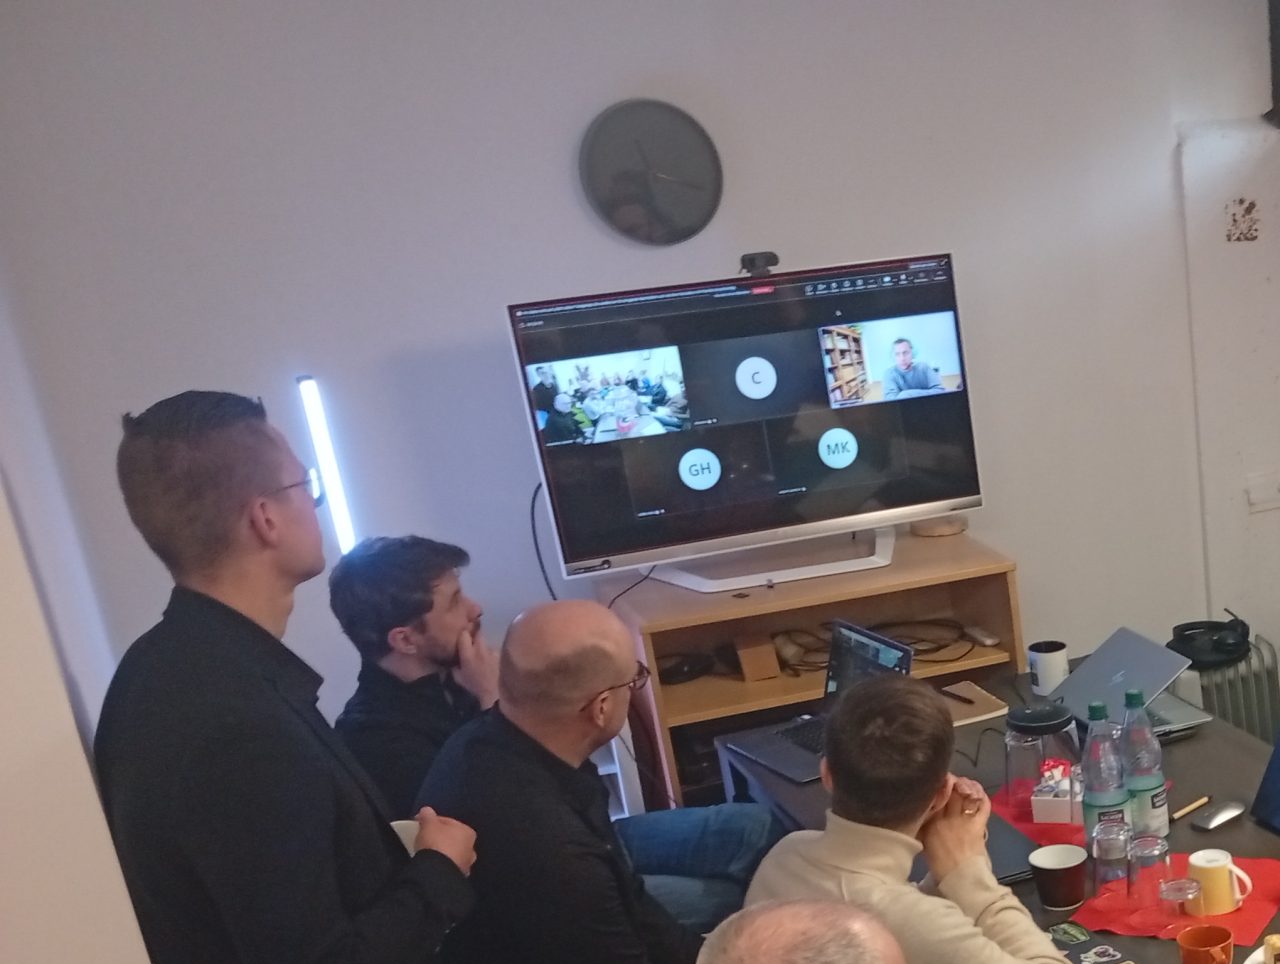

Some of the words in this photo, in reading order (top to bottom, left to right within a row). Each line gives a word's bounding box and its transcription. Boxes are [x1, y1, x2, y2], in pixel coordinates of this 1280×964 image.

[751, 371, 762, 385] C
[826, 441, 852, 456] MK
[688, 462, 712, 477] GH
